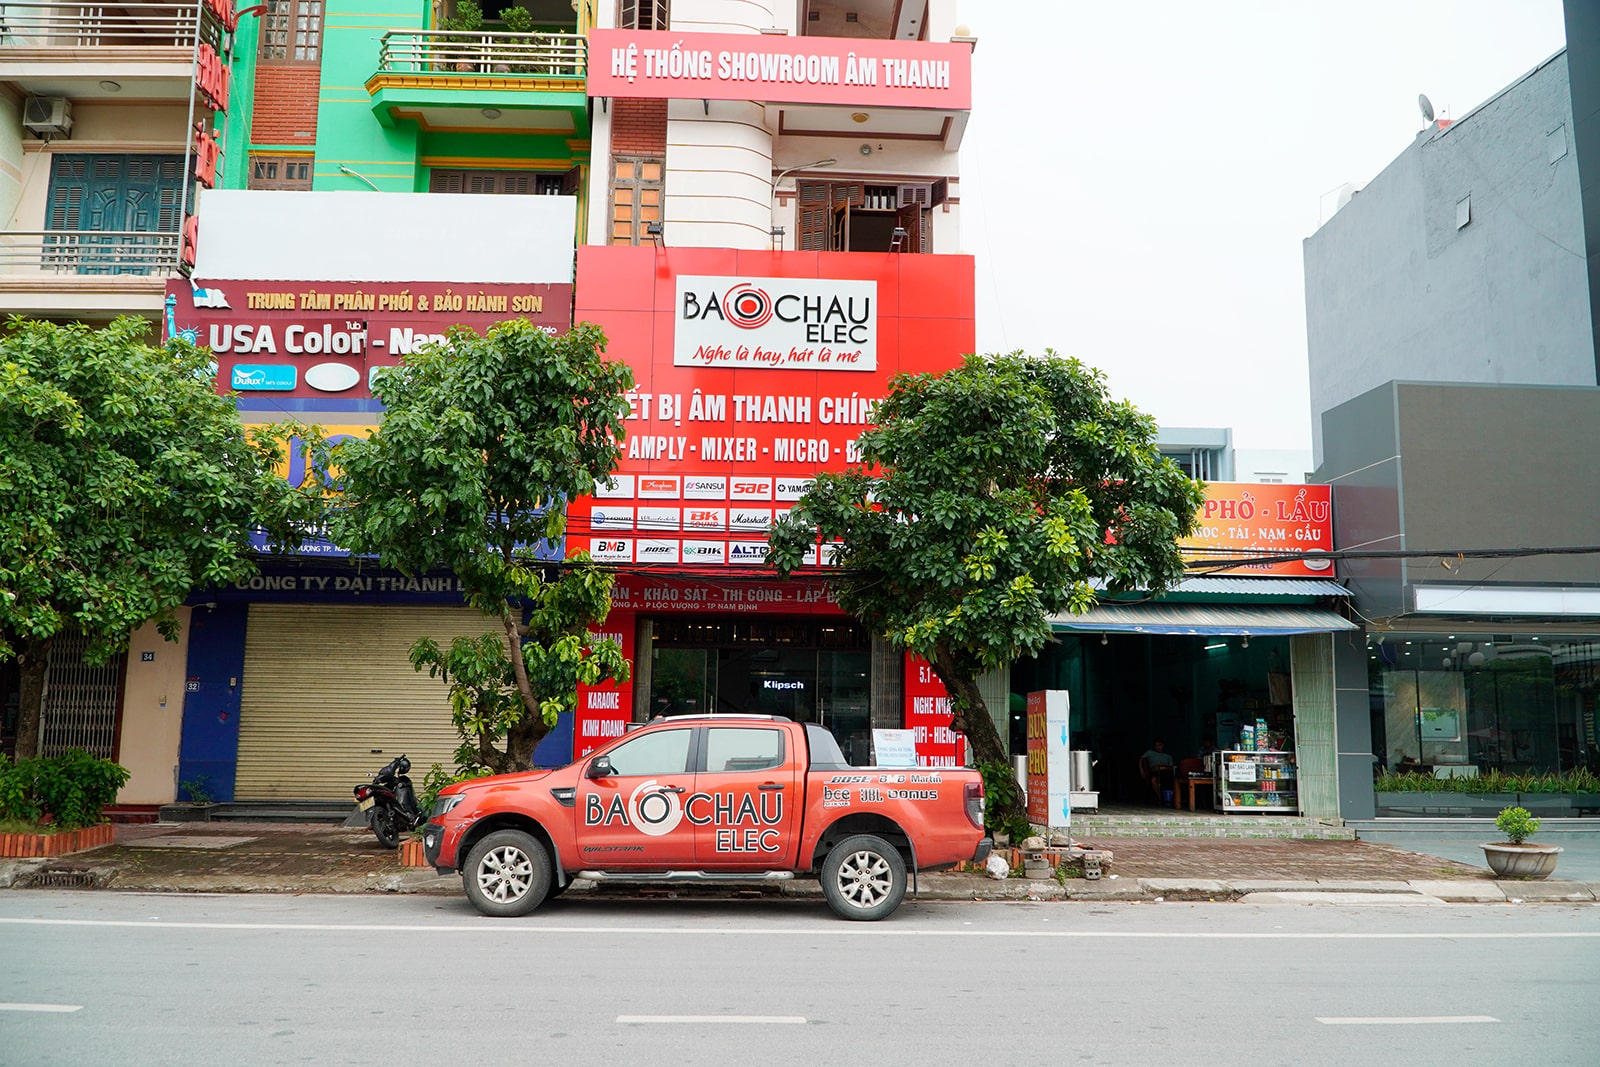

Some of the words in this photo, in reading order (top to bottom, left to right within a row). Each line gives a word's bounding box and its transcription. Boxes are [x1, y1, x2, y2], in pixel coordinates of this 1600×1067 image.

[611, 42, 638, 84] HỆ
[643, 39, 712, 80] THỐNG
[717, 51, 839, 85] SHOWROOM
[844, 51, 877, 87] ÂM
[882, 58, 950, 90] THANH
[247, 292, 295, 310] TRUNG
[300, 289, 331, 310] TÂM
[334, 290, 375, 311] PHÂN
[379, 289, 412, 311] PHỐI
[417, 294, 429, 312] &
[434, 288, 462, 312] BẢO
[466, 290, 507, 312] HÀNH
[512, 295, 543, 312] SƠN
[209, 324, 277, 353] USA
[285, 323, 366, 354] Color
[806, 324, 868, 344] ELEC
[693, 345, 731, 364] Nghe
[736, 345, 749, 360] là
[788, 347, 813, 362] hát
[818, 347, 831, 362] là
[836, 351, 861, 362] mê
[234, 376, 261, 385] Dulux
[658, 393, 682, 427] BỊ
[688, 389, 726, 421] ÂM
[732, 394, 811, 423] THANH
[819, 392, 880, 424] CHÍN
[628, 435, 687, 460] AMPLY
[702, 437, 757, 461] MIXER
[774, 438, 829, 463] MICRO
[695, 482, 725, 490] SANSUI
[1204, 492, 1255, 520] PHỞ
[1277, 489, 1328, 522] LẨU
[691, 511, 719, 520] BK
[731, 513, 769, 524] Marshall
[1228, 525, 1248, 539] TÁI
[1259, 528, 1285, 542] NẠM
[1295, 524, 1321, 540] GẦU
[598, 541, 626, 552] BMB
[697, 547, 721, 555] BIK
[301, 576, 330, 591] TY
[334, 577, 372, 595] ĐẠI
[644, 583, 678, 601] KHẢO
[684, 585, 708, 601] SÁT
[723, 588, 742, 601] THI
[747, 587, 782, 602] CÔNG
[652, 601, 668, 611] LỘC
[672, 602, 699, 611] VƯỢNG
[920, 666, 930, 683] 5.1
[763, 680, 804, 690] Klipsch
[588, 692, 619, 709] KARAOKE
[914, 697, 933, 714] NGHE
[582, 720, 599, 736] KINH
[601, 720, 624, 736] DOANH
[1028, 705, 1046, 739] BÚN
[914, 727, 927, 743] HIFI
[824, 775, 876, 784] BOSE
[911, 774, 942, 783] Martin
[824, 787, 850, 800] bce
[861, 789, 883, 802] JBL
[715, 829, 780, 852] ELEC
